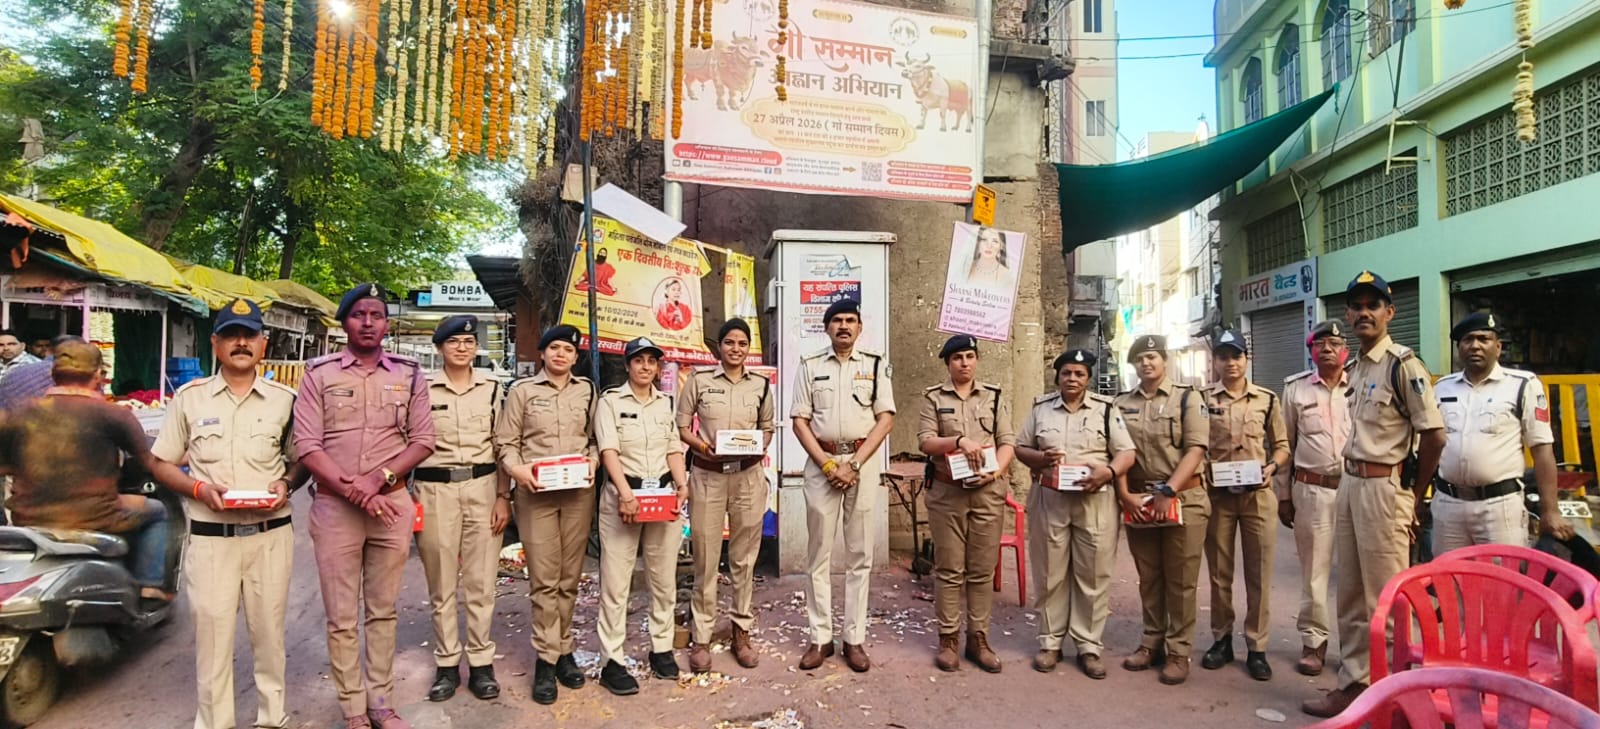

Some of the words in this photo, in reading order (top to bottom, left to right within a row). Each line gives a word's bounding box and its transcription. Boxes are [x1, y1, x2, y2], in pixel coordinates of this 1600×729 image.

[809, 36, 896, 72] सम्मान
[832, 73, 903, 99] अभियान
[753, 113, 765, 123] 27
[797, 118, 822, 129] 2026
[845, 124, 872, 135] सम्मान
[875, 124, 898, 137] दिवस
[617, 248, 632, 261] एक
[634, 248, 662, 268] दिवसीय
[838, 282, 858, 293] पुलिस
[1239, 277, 1270, 302] भारत
